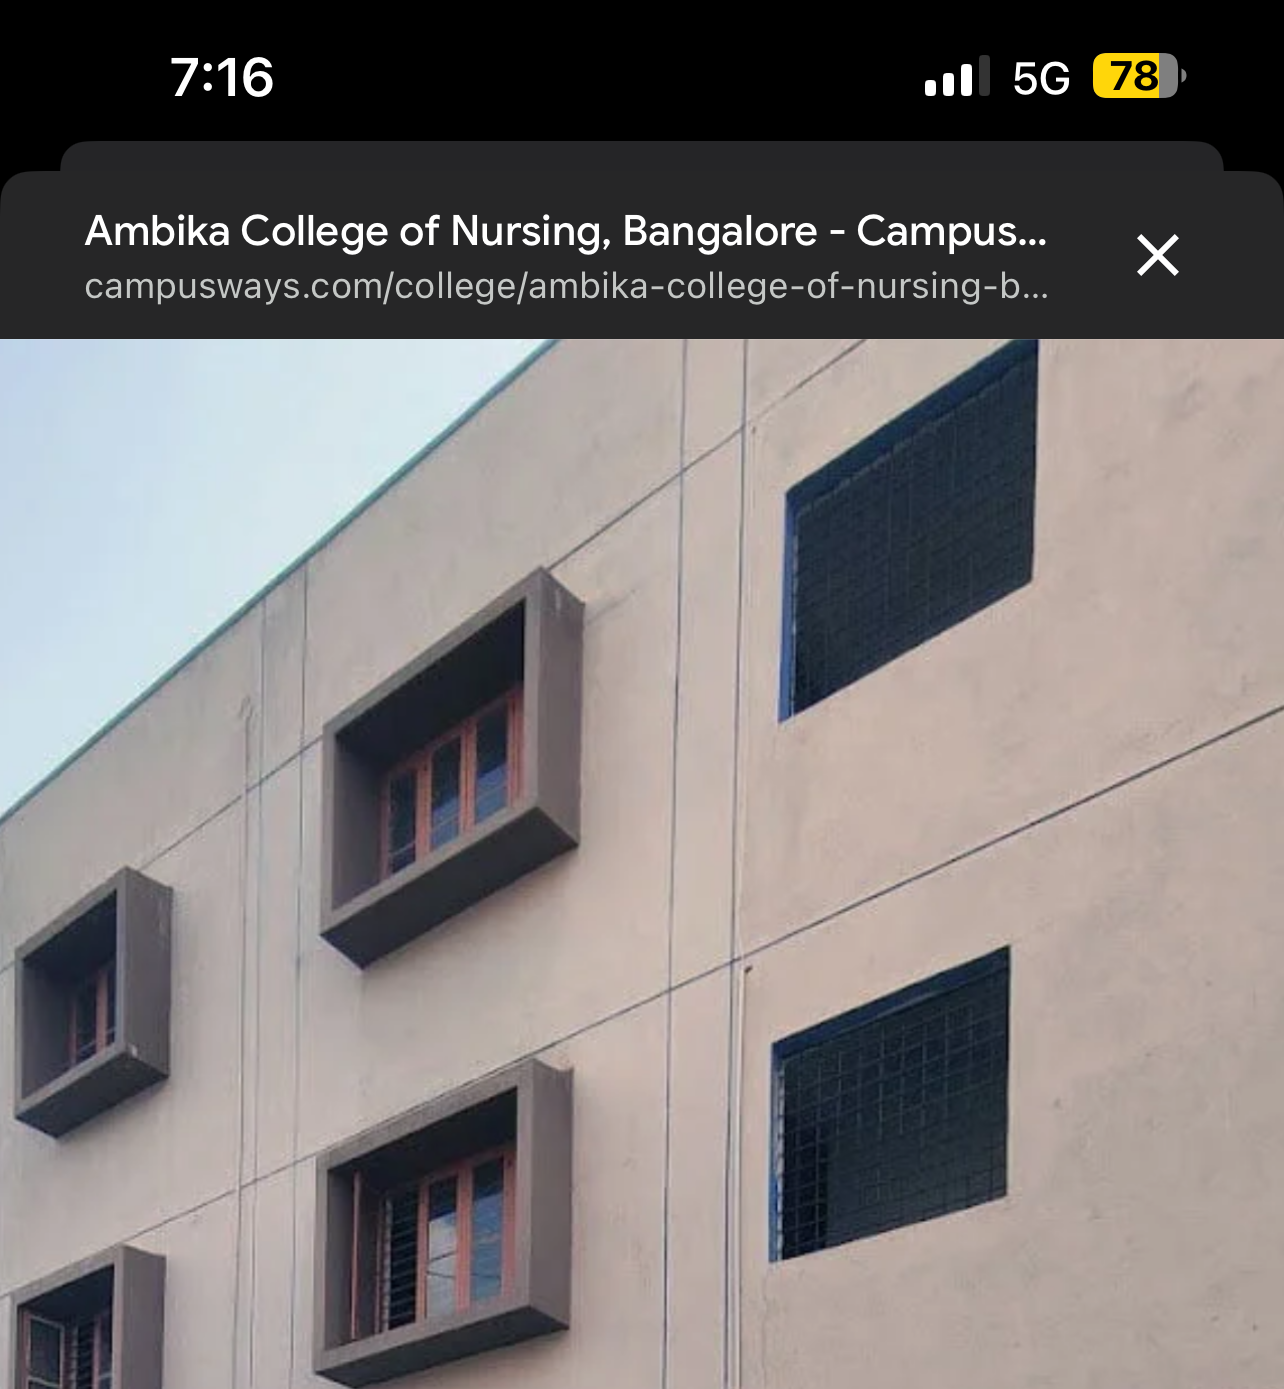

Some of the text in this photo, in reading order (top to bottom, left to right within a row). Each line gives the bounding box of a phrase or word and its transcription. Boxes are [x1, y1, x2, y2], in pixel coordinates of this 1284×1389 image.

[171, 57, 273, 97] 7:16
[1014, 61, 1070, 96] 5G
[1110, 60, 1159, 92] 78
[85, 213, 229, 247] Ambika
[242, 213, 388, 256] College
[400, 214, 440, 247] of
[453, 213, 610, 256] Nursing,
[624, 214, 817, 256] Bangalore
[858, 213, 1047, 255] Campus...
